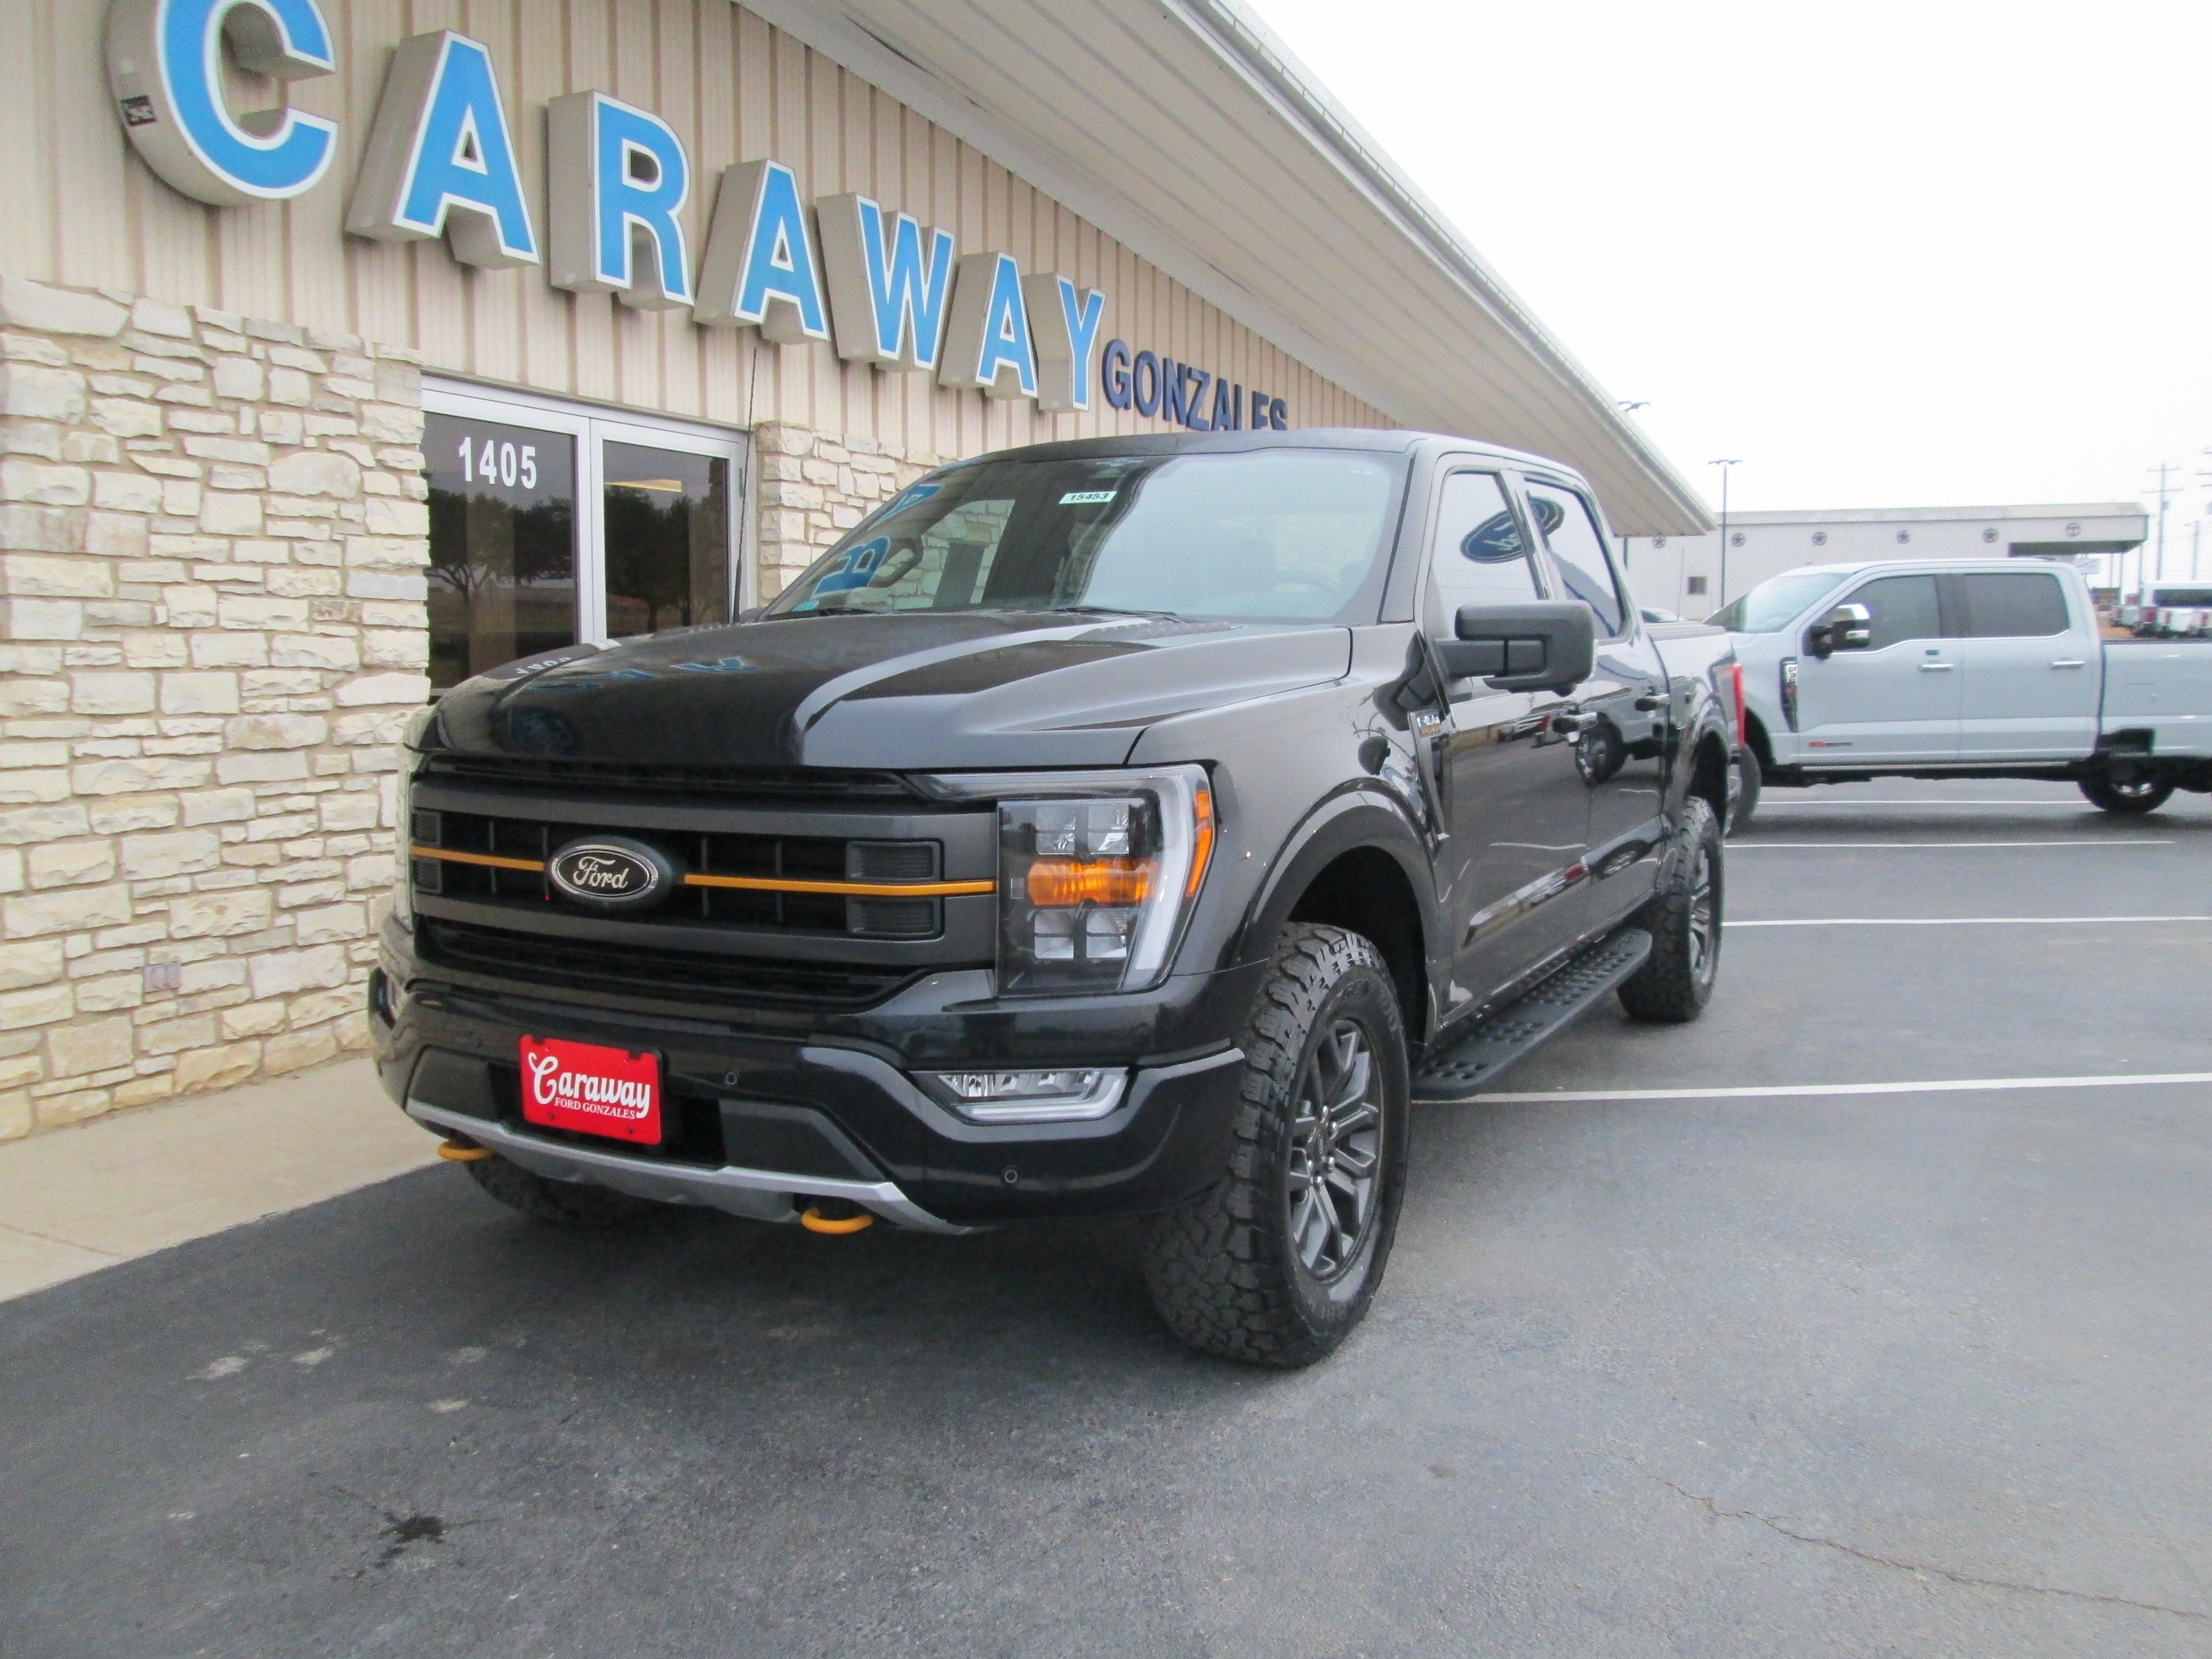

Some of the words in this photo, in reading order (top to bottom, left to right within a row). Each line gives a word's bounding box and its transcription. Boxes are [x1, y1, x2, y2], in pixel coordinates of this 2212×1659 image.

[154, 0, 1106, 412] CARAWAY
[458, 436, 538, 489] 1405
[572, 856, 630, 889] Ford
[527, 1052, 651, 1119] Caraway
[554, 1097, 581, 1110] FORD
[582, 1102, 636, 1120] GONZALES
